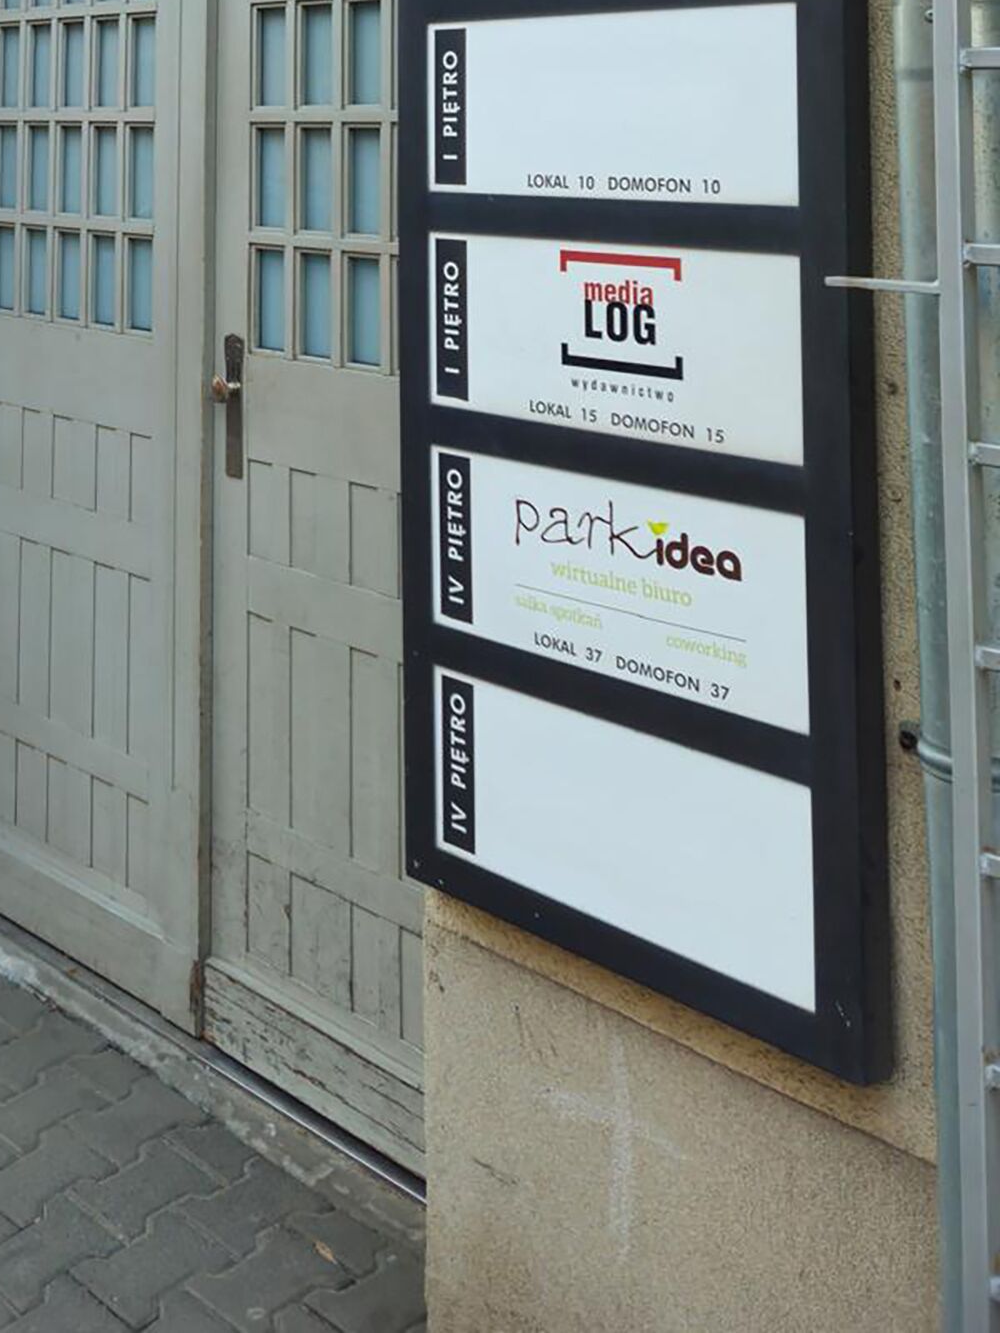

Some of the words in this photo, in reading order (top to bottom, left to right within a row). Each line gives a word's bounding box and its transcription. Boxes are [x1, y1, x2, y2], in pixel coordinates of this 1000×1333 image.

[443, 50, 461, 137] PIĘTRO
[527, 174, 569, 189] LOKAL
[579, 176, 595, 190] 10
[608, 176, 691, 194] DOMOFON
[702, 179, 721, 194] 10
[444, 260, 462, 351] PIĘTRO
[584, 280, 654, 307] media
[584, 299, 656, 346] LOG
[444, 366, 460, 374] I
[571, 377, 675, 404] wydawnictwo
[529, 399, 572, 420] LOKAL
[581, 408, 597, 423] 15
[610, 412, 695, 439] DOMOFON
[706, 427, 725, 444] 15
[446, 468, 465, 562] PIĘTRO
[448, 577, 465, 605] IV
[550, 561, 638, 594] wirtualne
[643, 578, 692, 607] biuro
[534, 632, 577, 657] LOKAL
[586, 646, 603, 663] 37
[616, 656, 700, 693] DOMOFON
[710, 683, 730, 701] 37
[666, 635, 747, 668] coworking
[449, 693, 469, 789] PIĘTRO
[450, 803, 467, 834] IV
